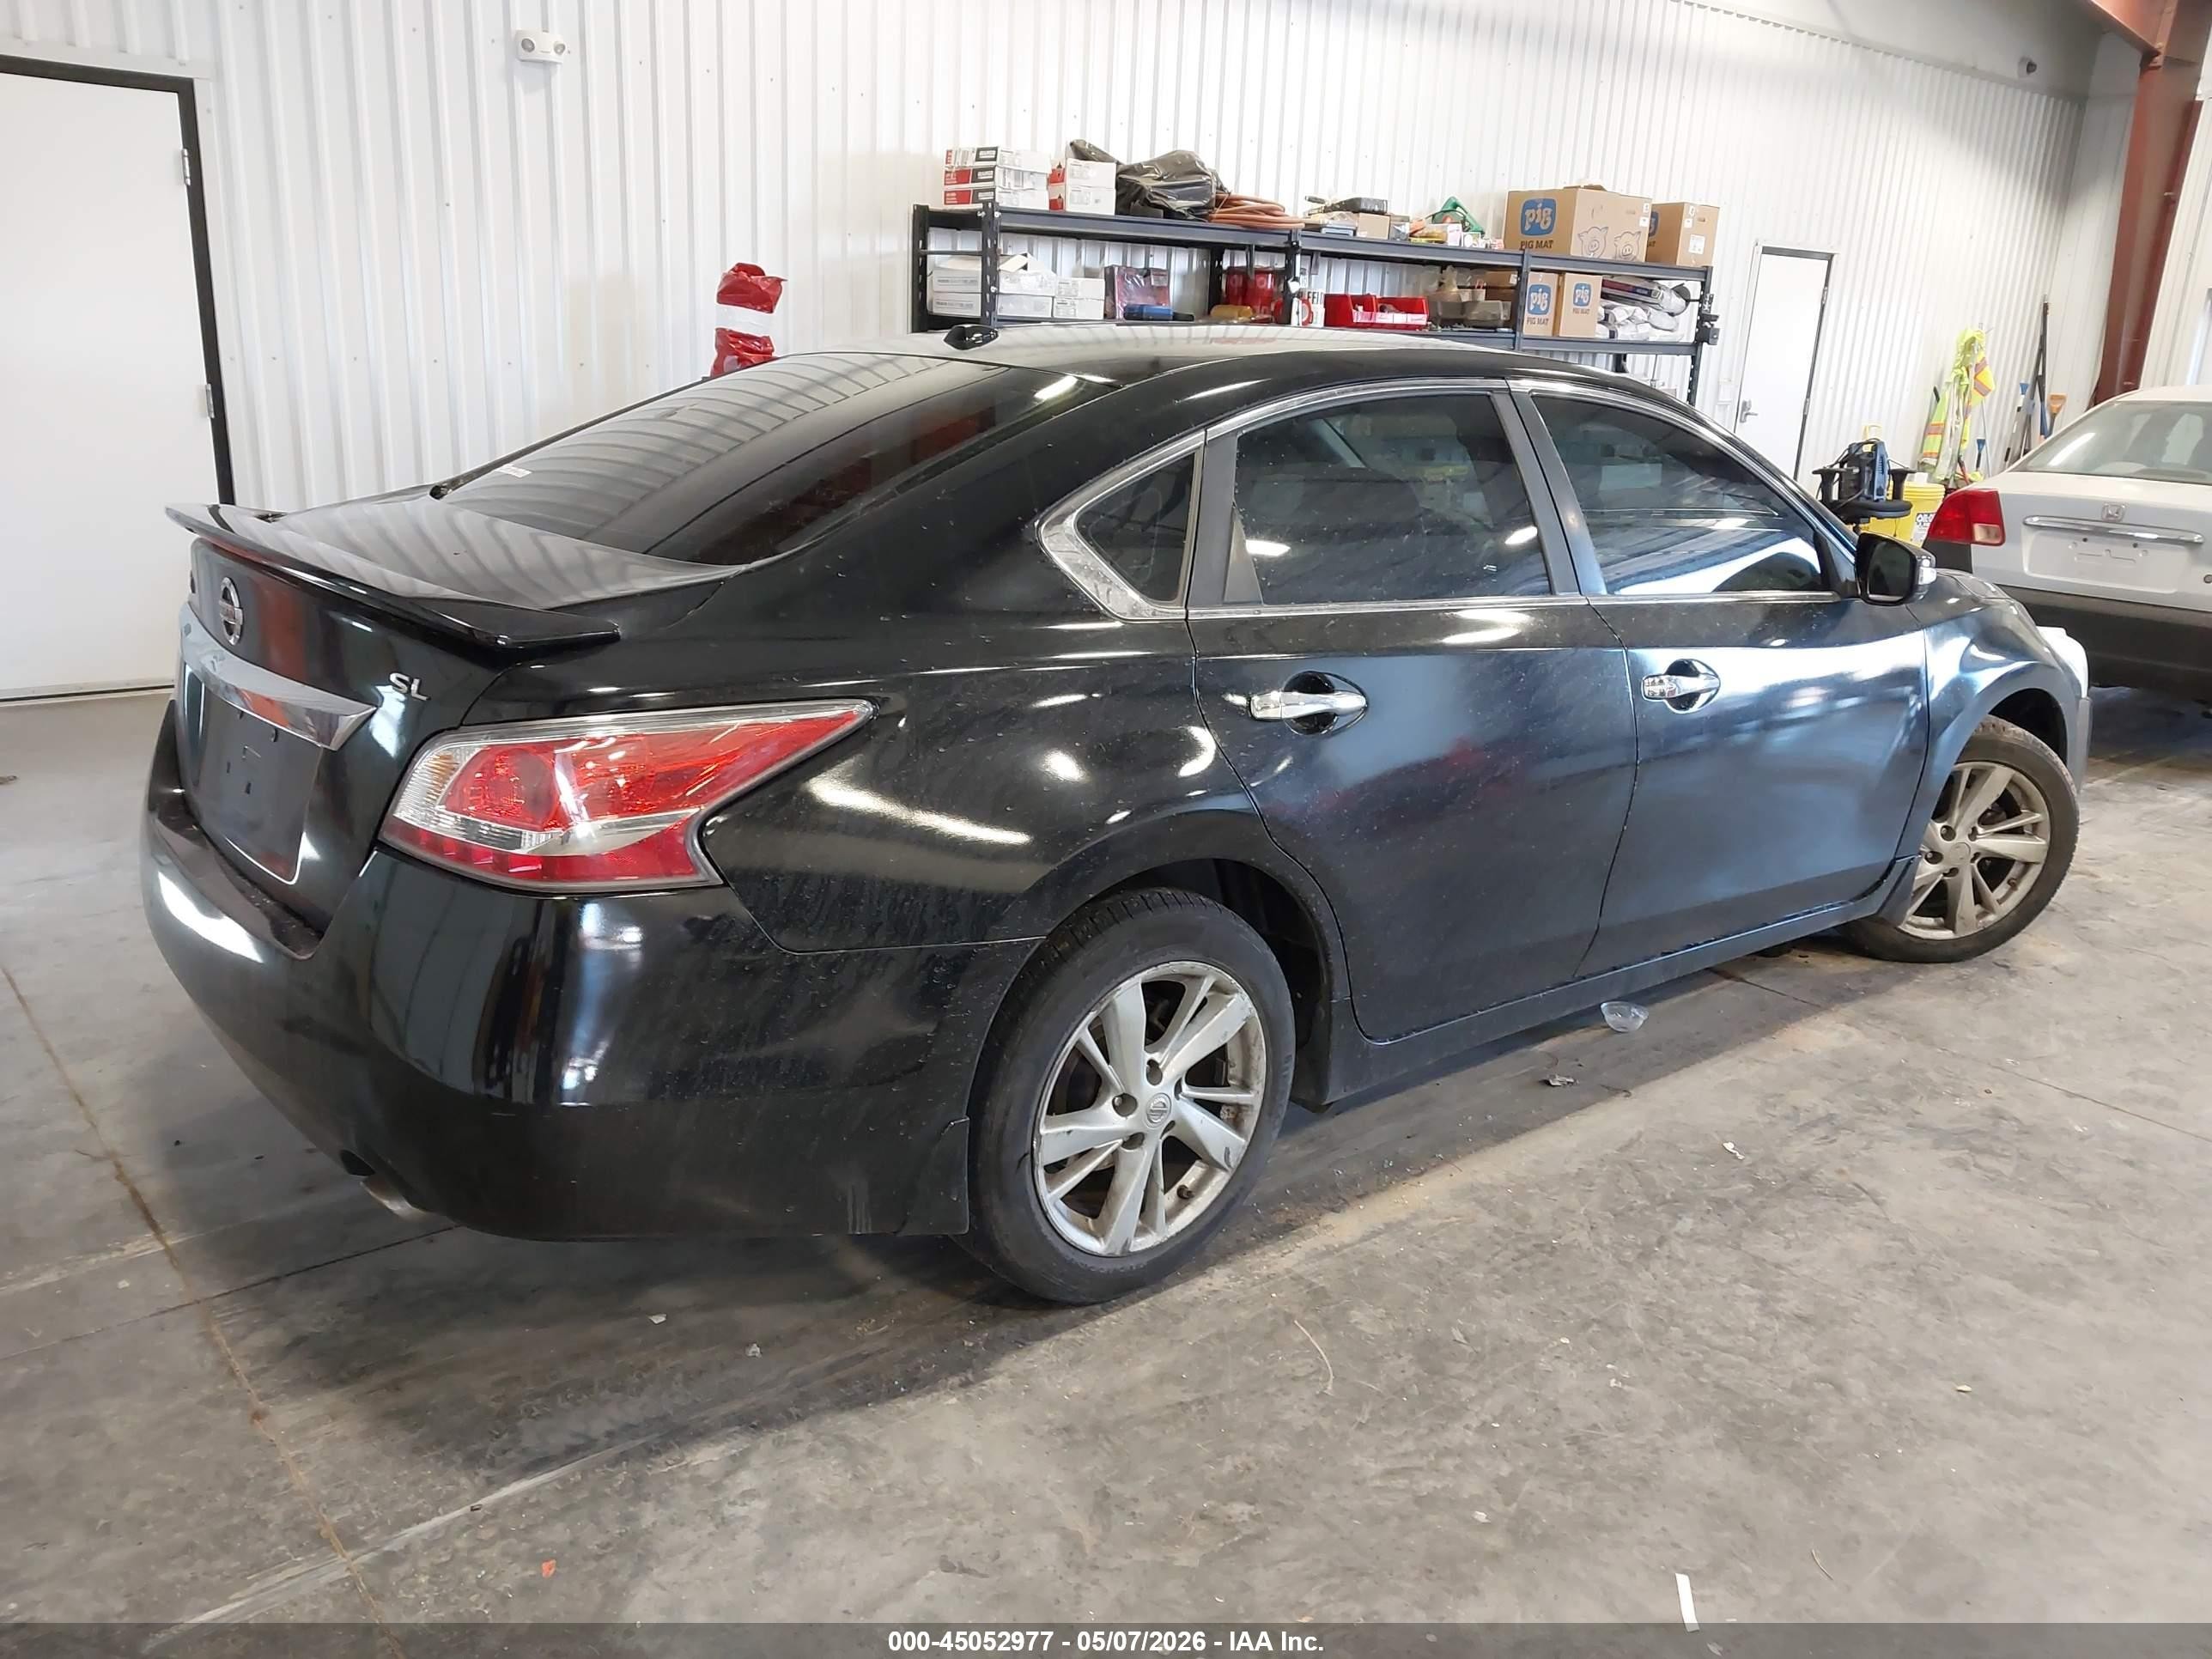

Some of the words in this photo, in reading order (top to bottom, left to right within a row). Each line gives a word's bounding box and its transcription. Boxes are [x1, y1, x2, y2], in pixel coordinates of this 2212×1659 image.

[1524, 204, 1553, 231] pig
[1520, 240, 1534, 250] PIG
[1536, 240, 1554, 249] MAT
[1530, 289, 1549, 311] pig
[1575, 286, 1589, 303] pig
[389, 672, 428, 701] SL
